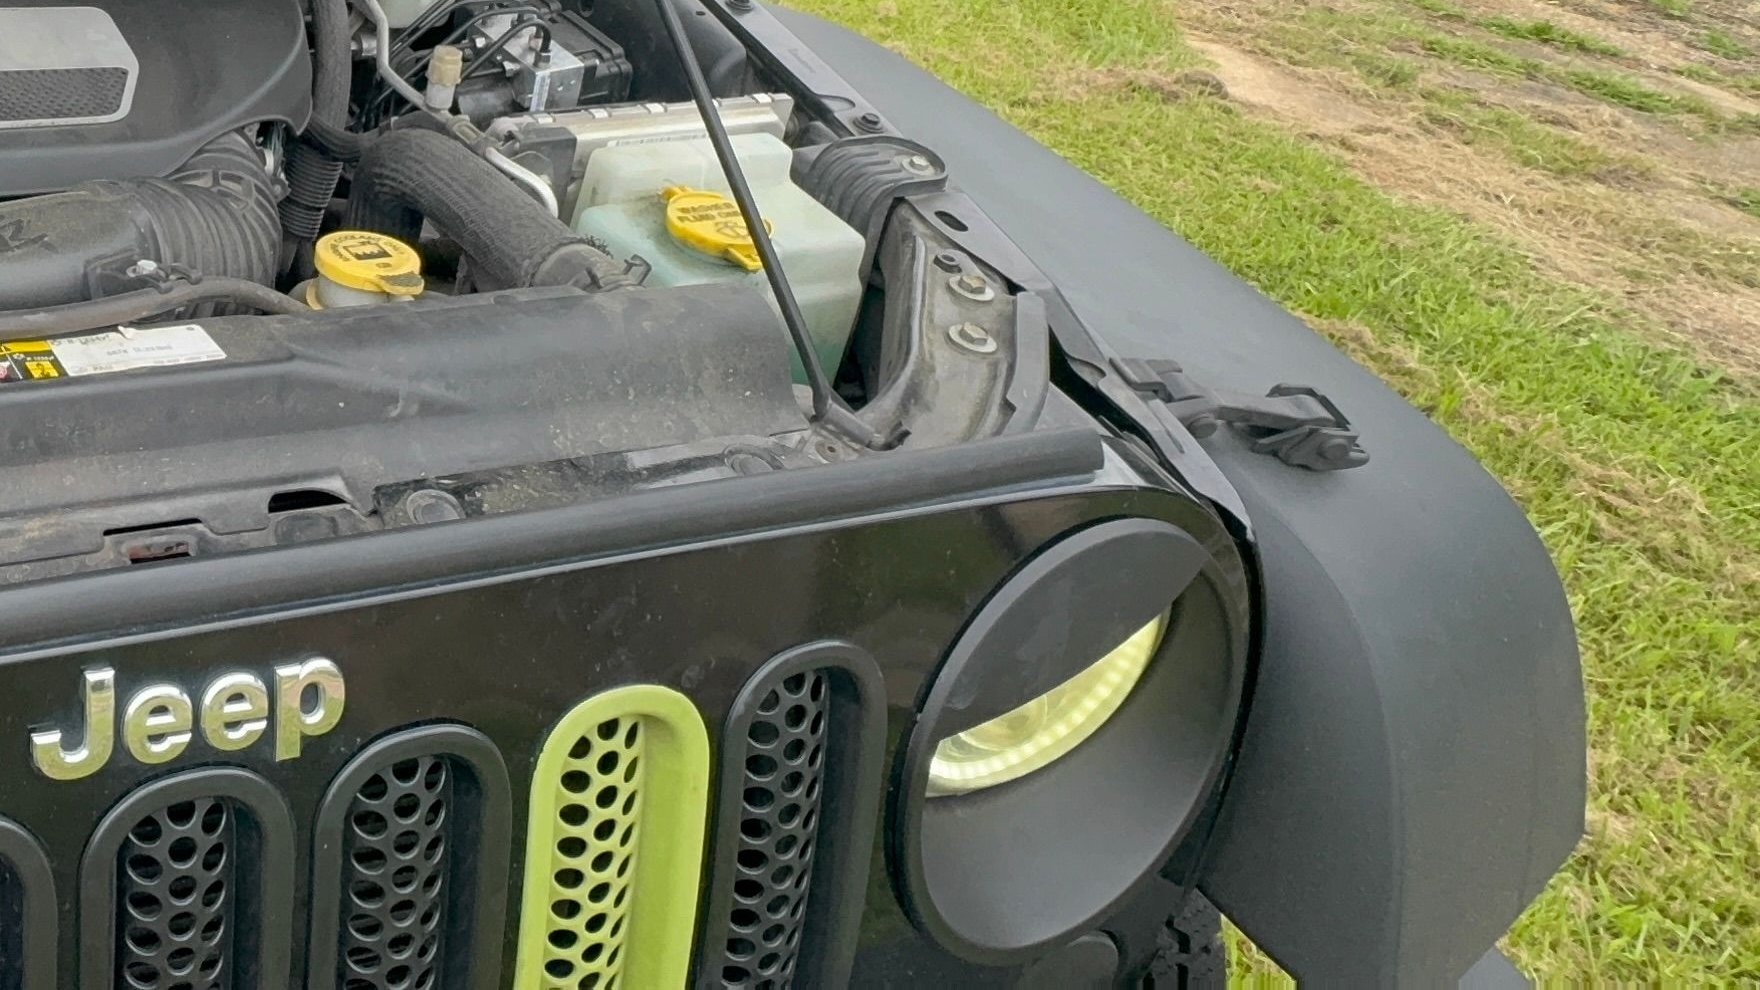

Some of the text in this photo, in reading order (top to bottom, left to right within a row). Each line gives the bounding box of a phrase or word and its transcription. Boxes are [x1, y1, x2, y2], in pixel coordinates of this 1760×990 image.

[676, 201, 735, 214] WASHER
[676, 213, 716, 223] FLUID
[29, 657, 346, 781] Jeep
